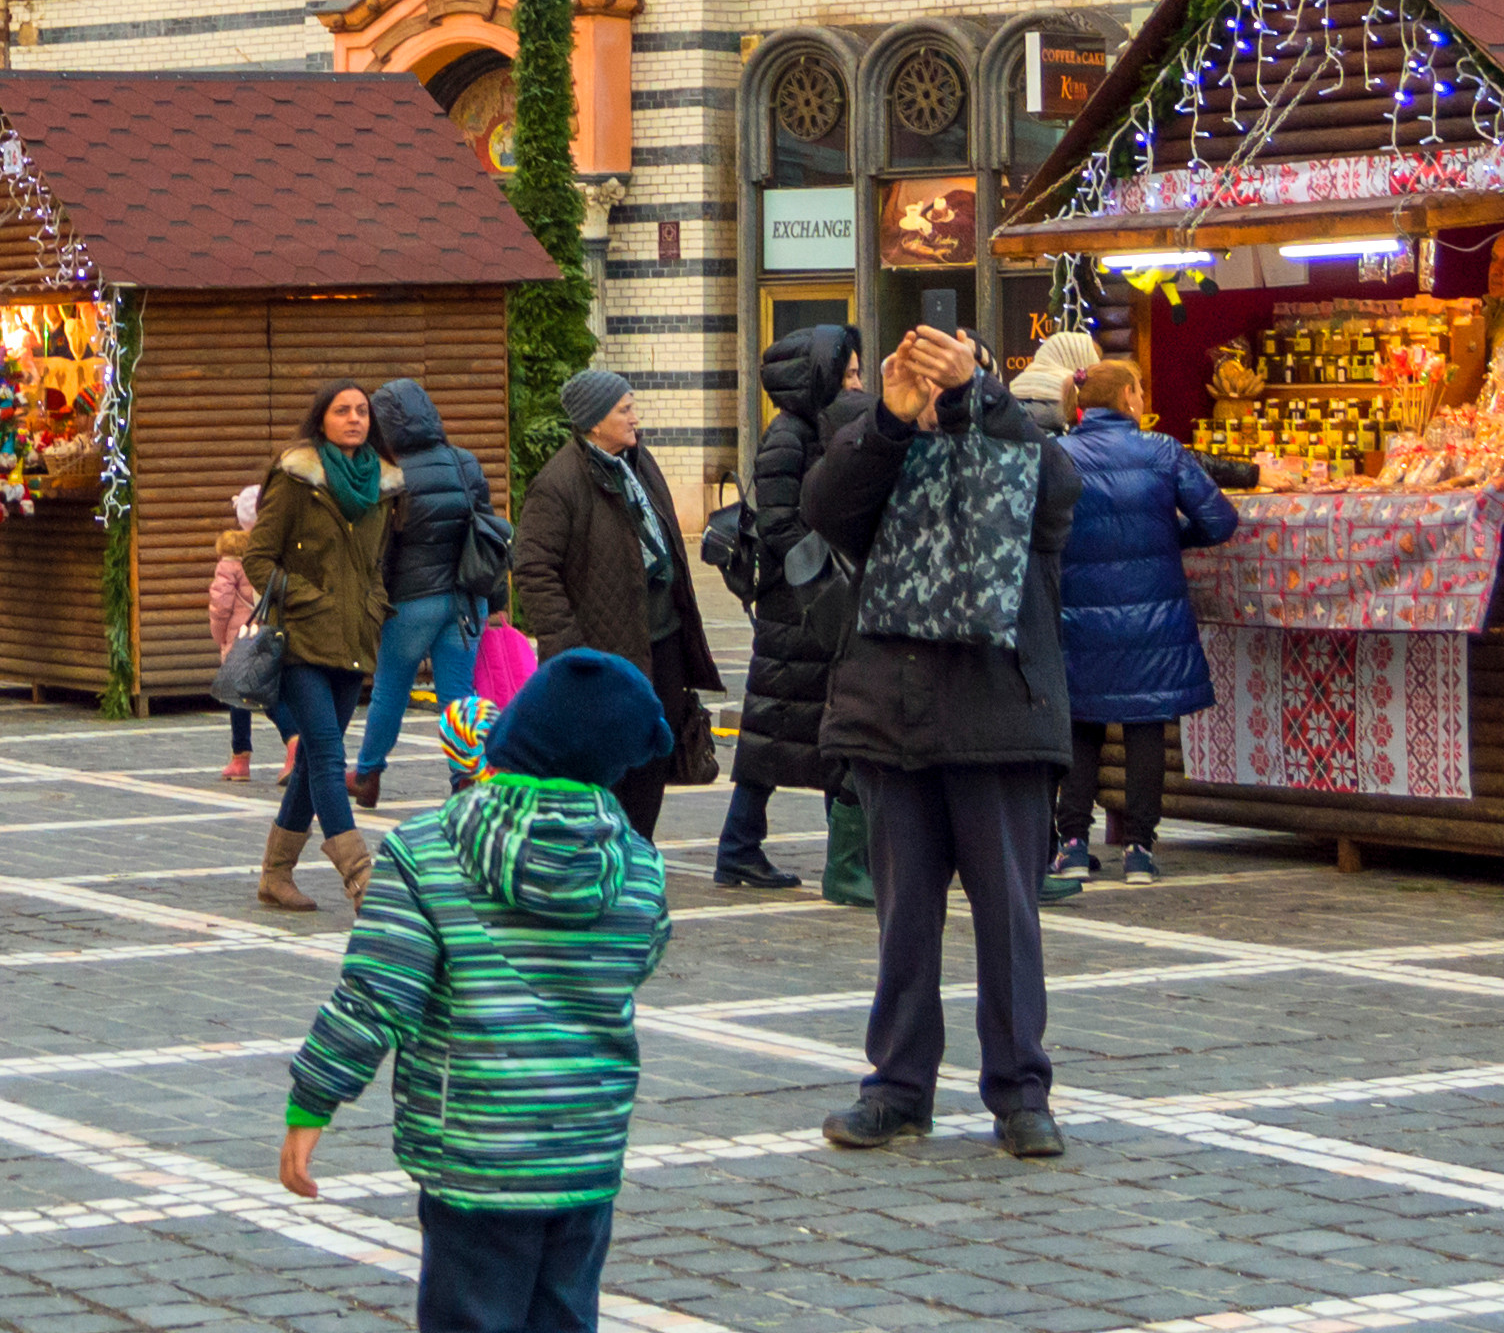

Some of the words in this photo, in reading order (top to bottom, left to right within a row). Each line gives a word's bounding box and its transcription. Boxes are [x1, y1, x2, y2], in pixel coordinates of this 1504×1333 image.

[1041, 47, 1075, 64] COFFEE
[1082, 51, 1105, 66] CAKE
[772, 220, 851, 239] EXCHANGE
